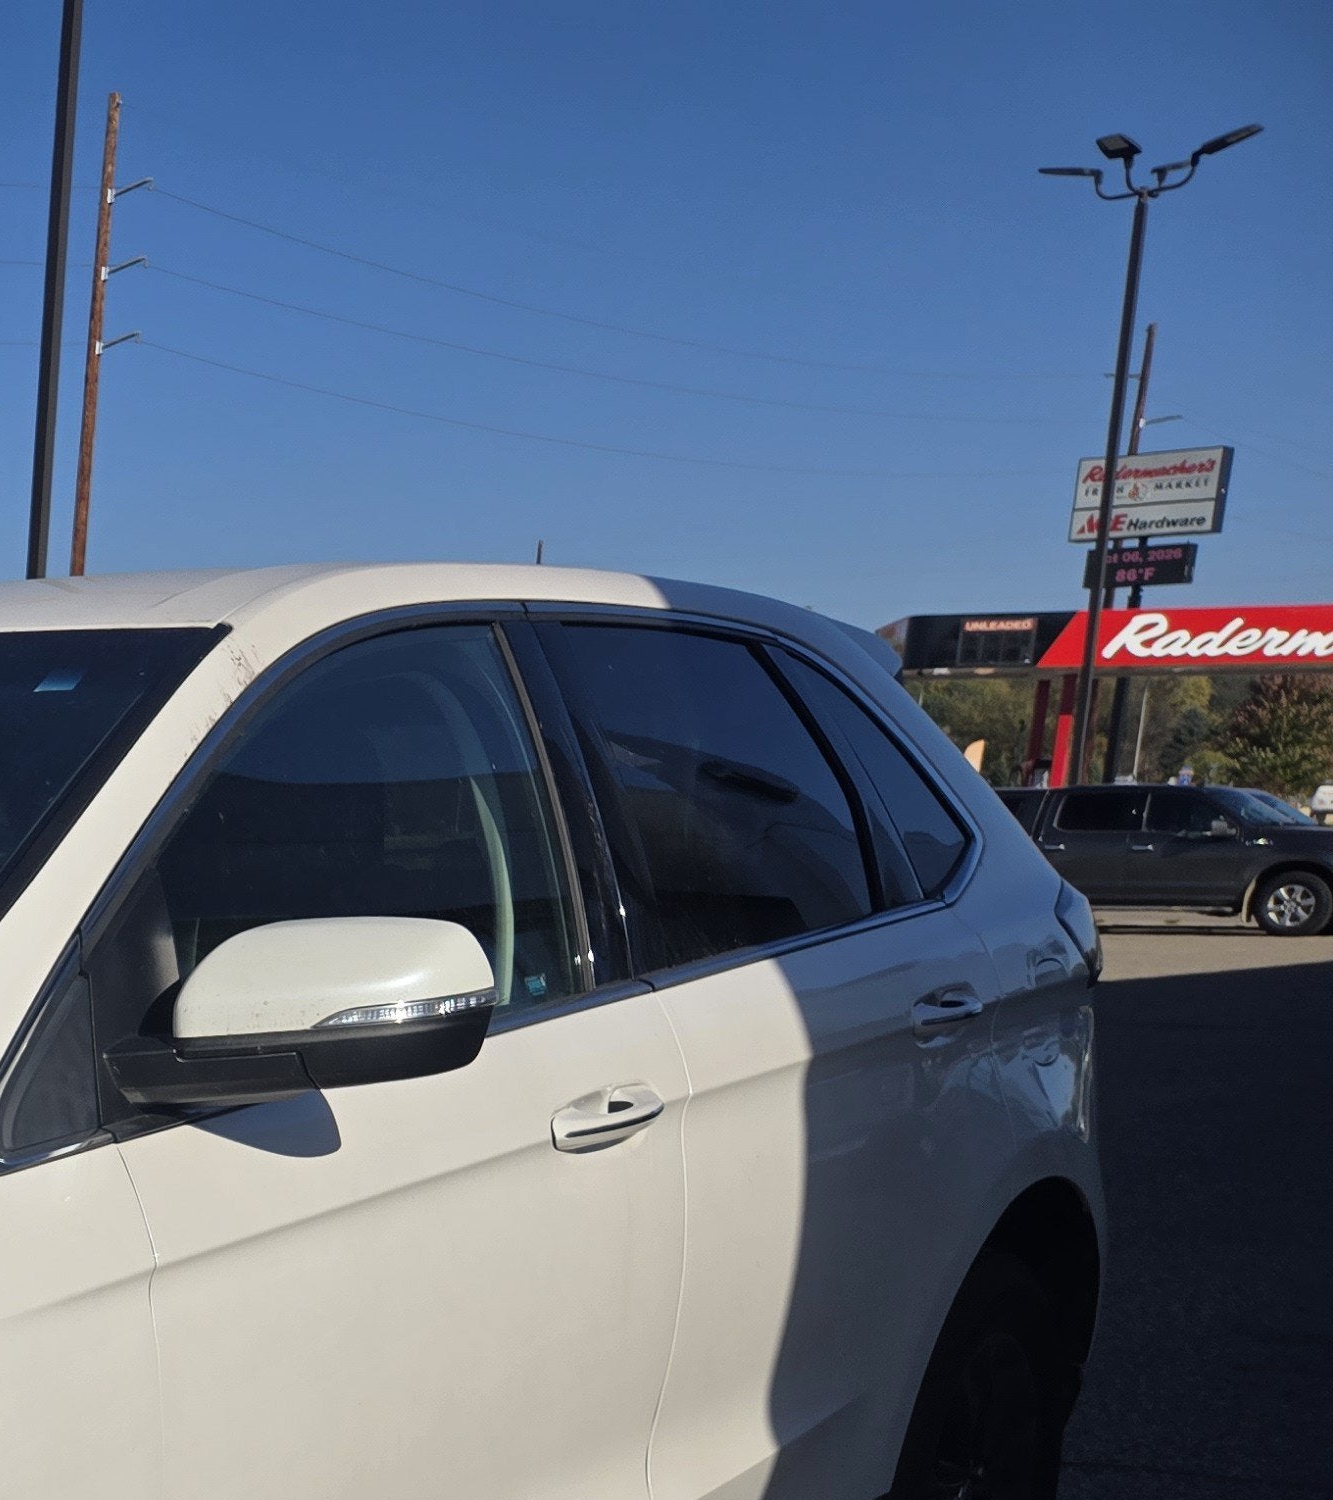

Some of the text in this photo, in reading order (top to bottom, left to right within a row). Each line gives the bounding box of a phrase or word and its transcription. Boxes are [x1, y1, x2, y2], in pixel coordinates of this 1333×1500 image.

[1154, 477, 1210, 491] MARKET
[1126, 515, 1206, 531] Hardware
[964, 618, 1035, 632] UNLEADED
